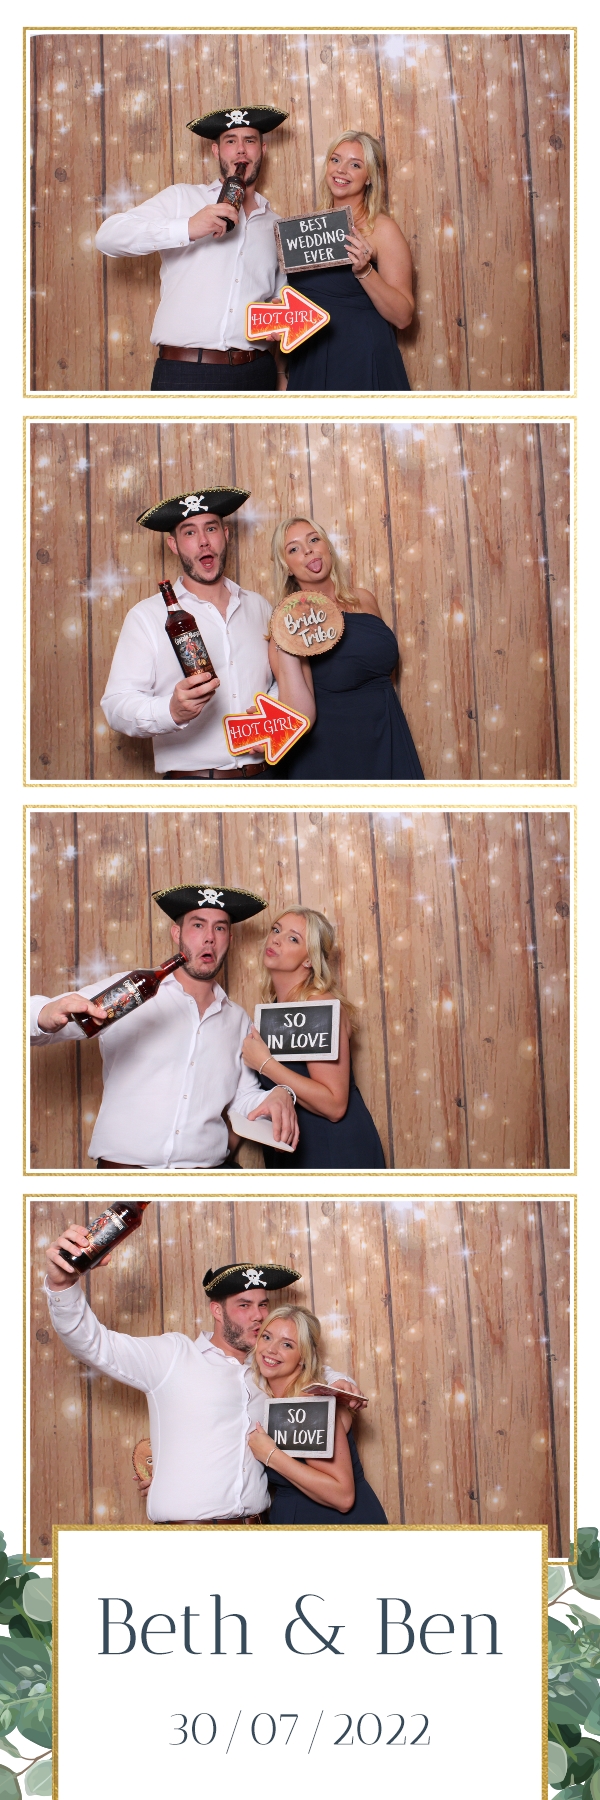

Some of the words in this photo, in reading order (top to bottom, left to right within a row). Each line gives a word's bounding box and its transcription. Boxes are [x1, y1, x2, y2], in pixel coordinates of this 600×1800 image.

[299, 216, 327, 233] BEST
[286, 228, 345, 251] WEDDING
[303, 247, 335, 263] EVER
[251, 311, 282, 325] HOT
[284, 310, 317, 325] GIRL
[283, 607, 327, 635] Bride
[297, 625, 337, 648] Tribe
[230, 721, 260, 739] HOT
[263, 715, 298, 735] GIRL
[283, 1012, 306, 1028] SO
[267, 1034, 284, 1050] IN
[290, 1032, 329, 1048] LOVE
[287, 1408, 306, 1424] SO
[274, 1429, 287, 1445] IN
[292, 1429, 325, 1445] LOVE
